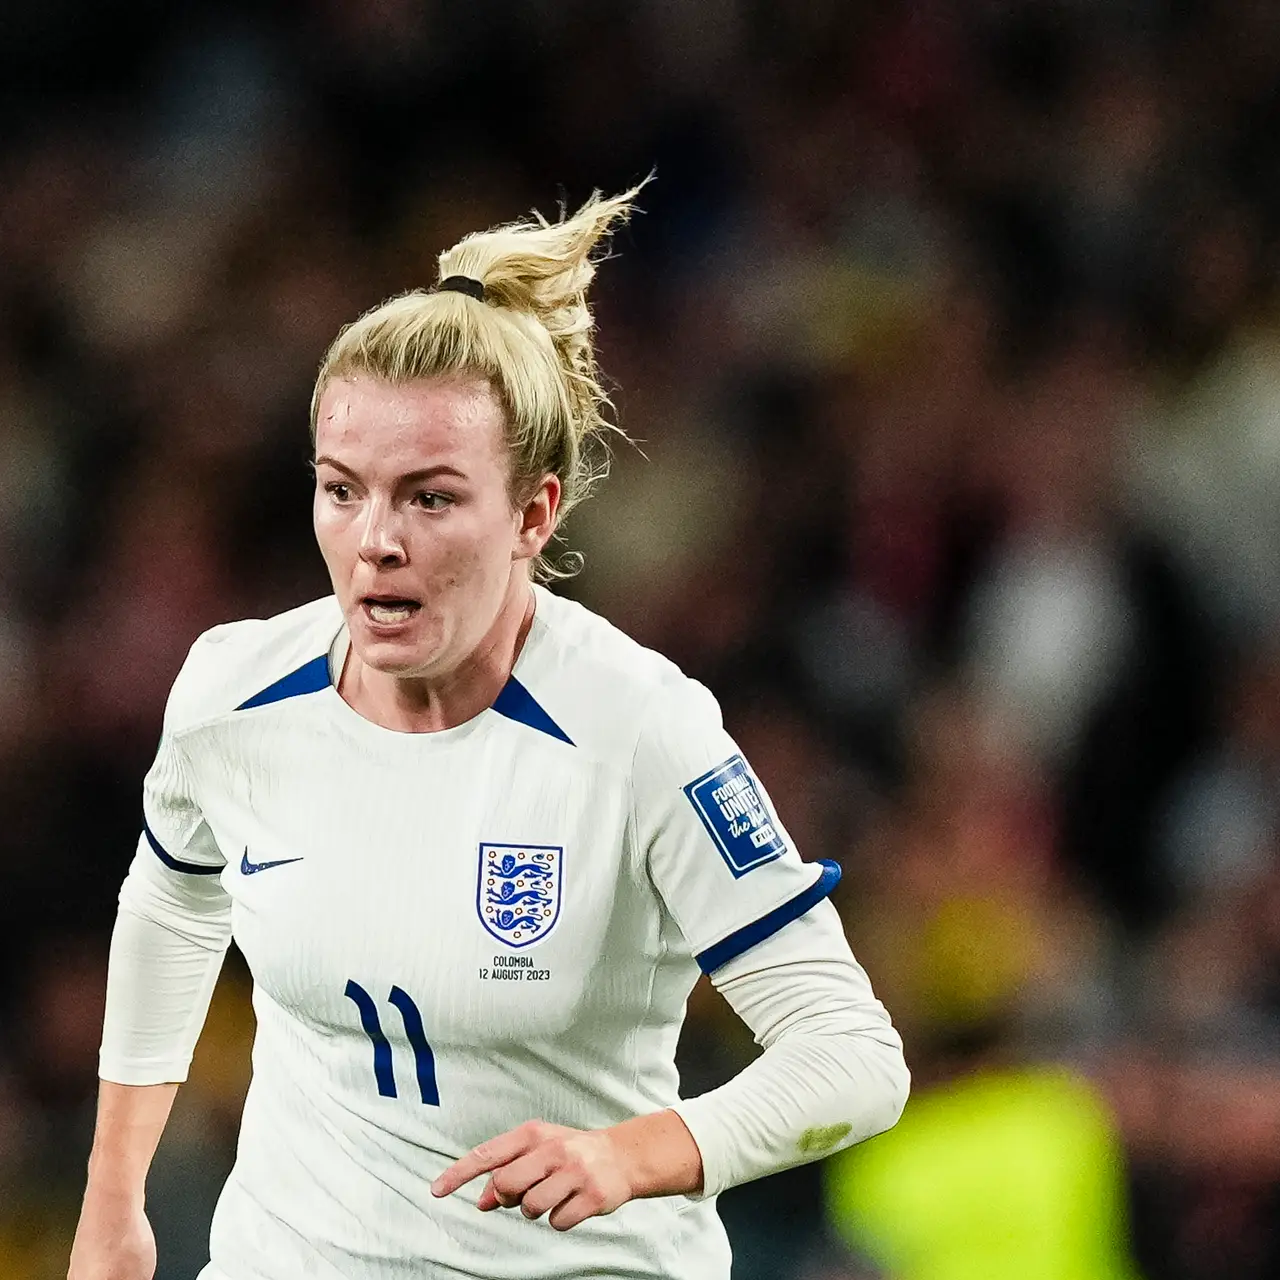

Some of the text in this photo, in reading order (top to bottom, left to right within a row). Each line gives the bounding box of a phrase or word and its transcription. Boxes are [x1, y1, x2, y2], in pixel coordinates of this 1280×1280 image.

[728, 819, 751, 838] the
[493, 955, 534, 968] COLOMBIA
[479, 968, 551, 981] 12 AUGUST 2023
[344, 979, 440, 1107] 11
